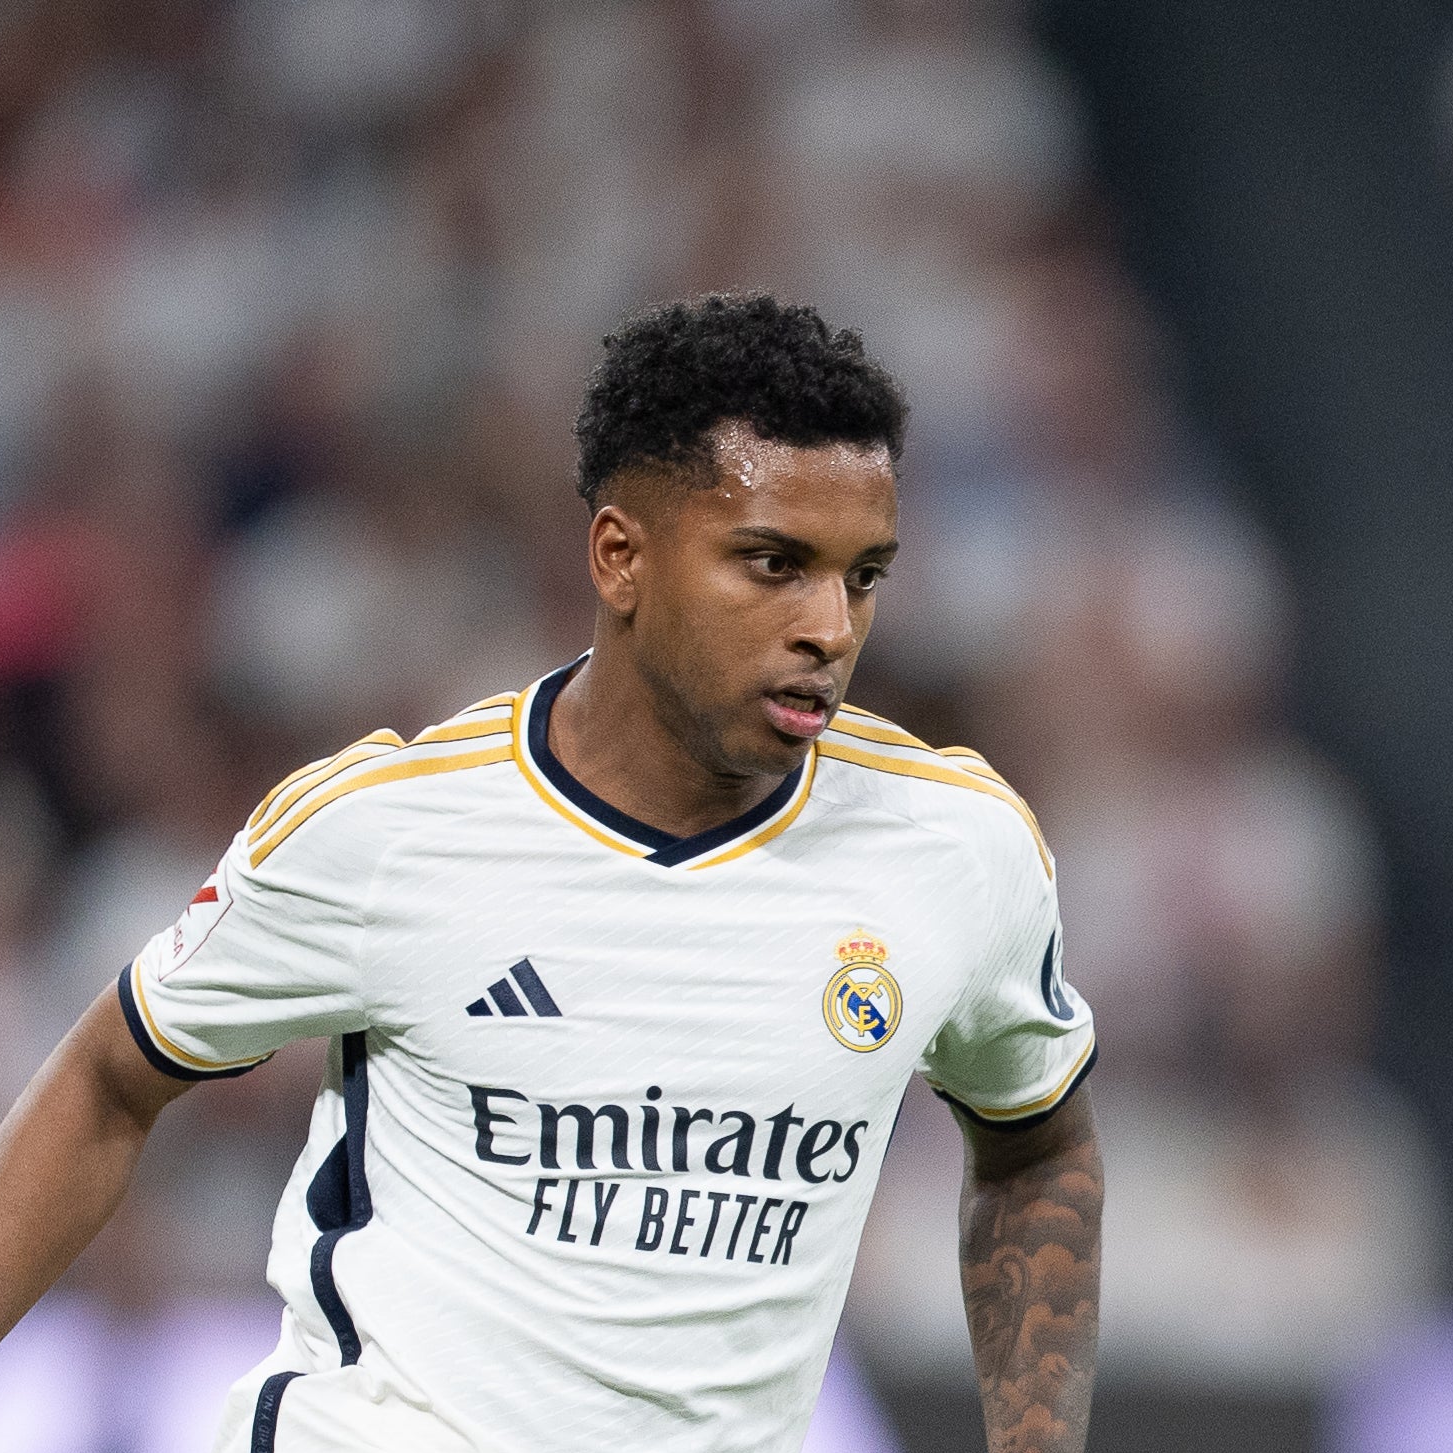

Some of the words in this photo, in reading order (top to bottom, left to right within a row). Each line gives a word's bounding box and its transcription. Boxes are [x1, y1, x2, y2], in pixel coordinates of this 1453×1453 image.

[466, 1085, 868, 1184] Emirates
[525, 1179, 620, 1247] FLY
[635, 1187, 809, 1265] BETTER
